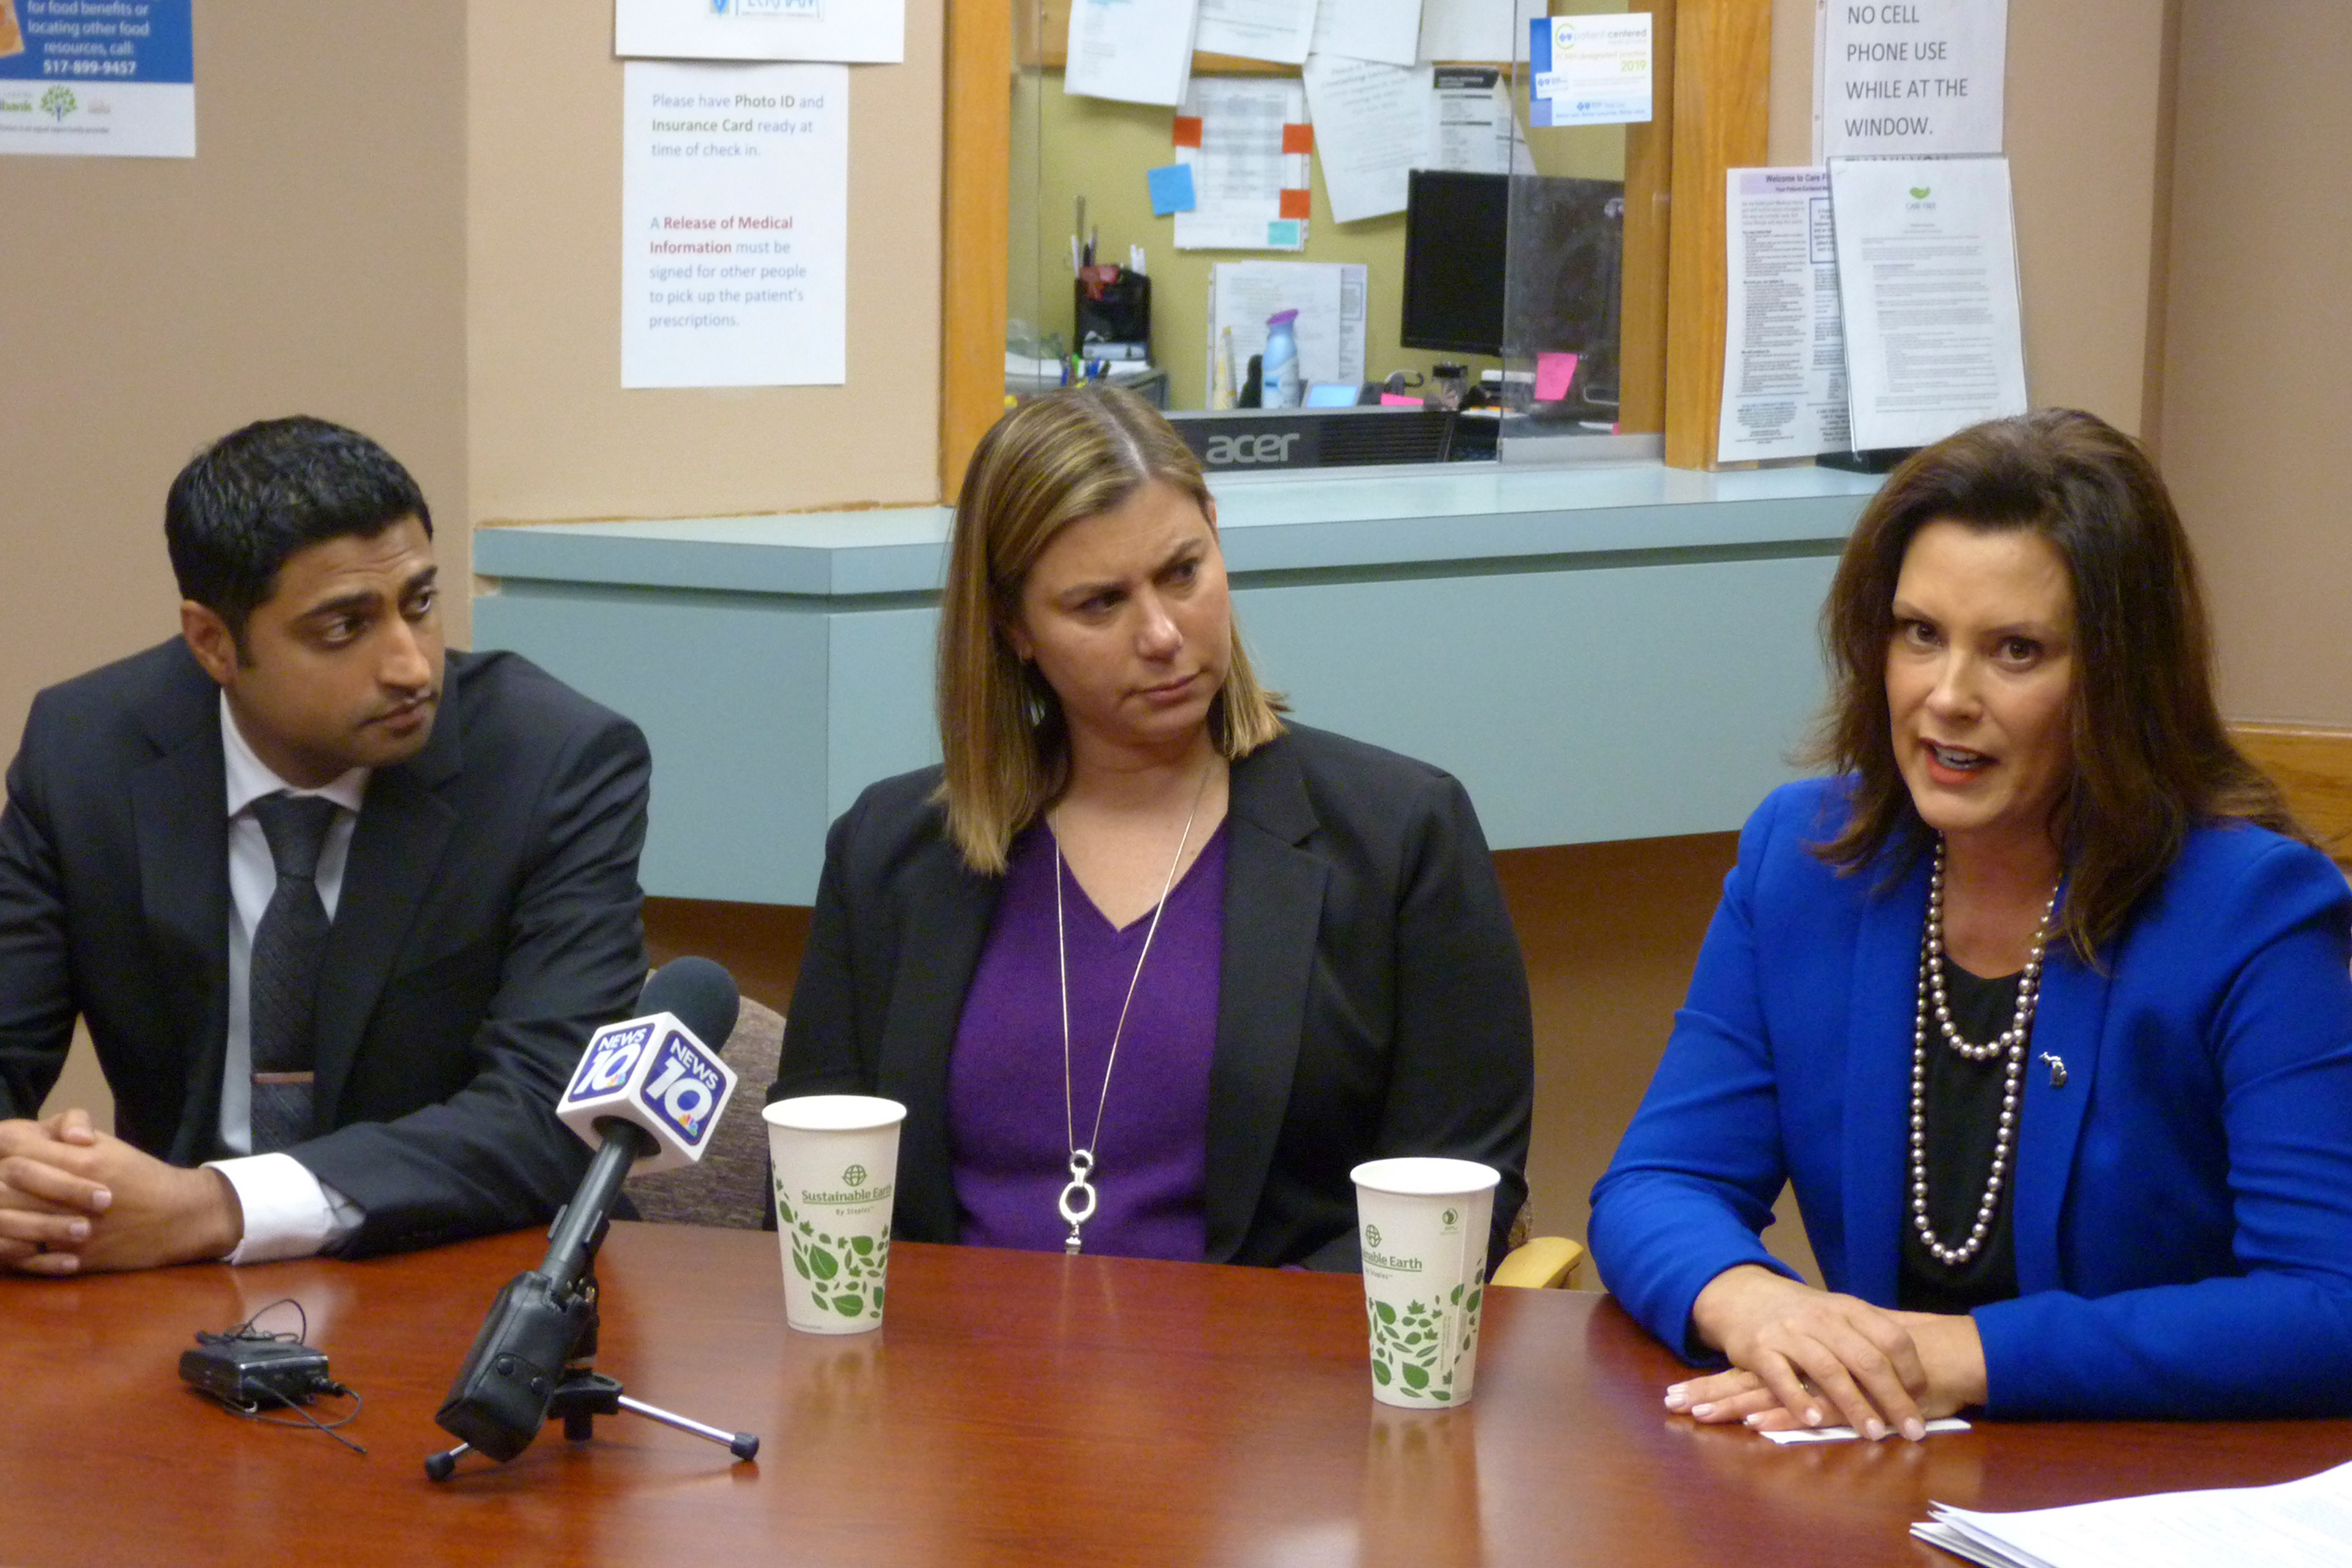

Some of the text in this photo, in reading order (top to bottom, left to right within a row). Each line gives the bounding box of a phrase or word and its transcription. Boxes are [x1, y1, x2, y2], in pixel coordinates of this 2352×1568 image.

[28, 0, 149, 16] for food benefits or
[1848, 5, 1920, 24] NO CELL
[28, 19, 150, 37] locating other food
[1607, 28, 1647, 39] centered
[44, 40, 135, 56] resources, call:
[1847, 41, 1948, 62] PHONE USE
[1621, 59, 1647, 71] 2019
[1846, 78, 1969, 99] WHILE AT THE
[652, 94, 824, 109] Please have Photo ID and
[652, 118, 813, 135] Insurance Card ready at
[1845, 117, 1934, 137] WINDOW.
[652, 142, 761, 157] time of check in.
[650, 215, 793, 230] A Release of Medical
[650, 240, 791, 255] Information must be
[650, 263, 807, 282] signed for other people
[650, 290, 663, 303] to
[667, 288, 693, 305] pick
[698, 292, 715, 305] up
[718, 288, 741, 303] the
[649, 313, 739, 330] prescriptions.
[1206, 432, 1300, 465] acer
[598, 1027, 647, 1052] NEWS
[573, 1043, 641, 1095] 10
[669, 1037, 719, 1090] NEWS
[646, 1055, 713, 1124] 10
[802, 1189, 871, 1202] Sustainable
[1389, 1256, 1422, 1269] Earth
